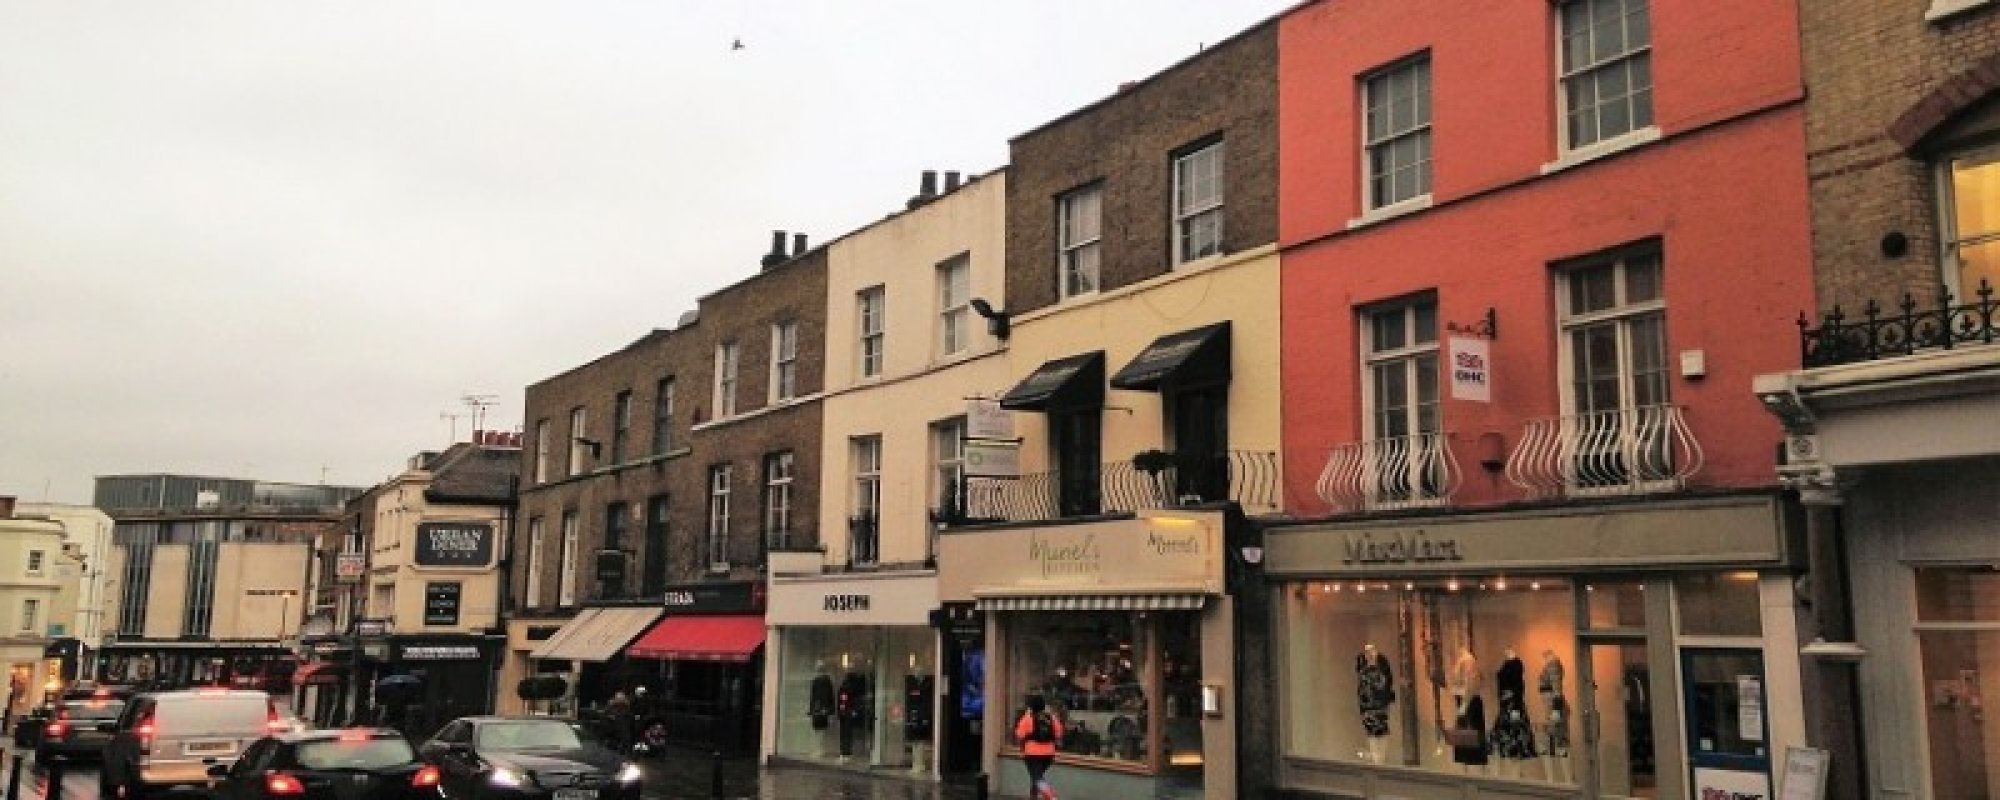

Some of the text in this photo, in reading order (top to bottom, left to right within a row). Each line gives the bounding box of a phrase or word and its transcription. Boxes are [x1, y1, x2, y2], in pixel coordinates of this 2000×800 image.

[429, 528, 483, 541] URBAN
[431, 540, 478, 551] DINER
[824, 594, 870, 611] JOSEPH
